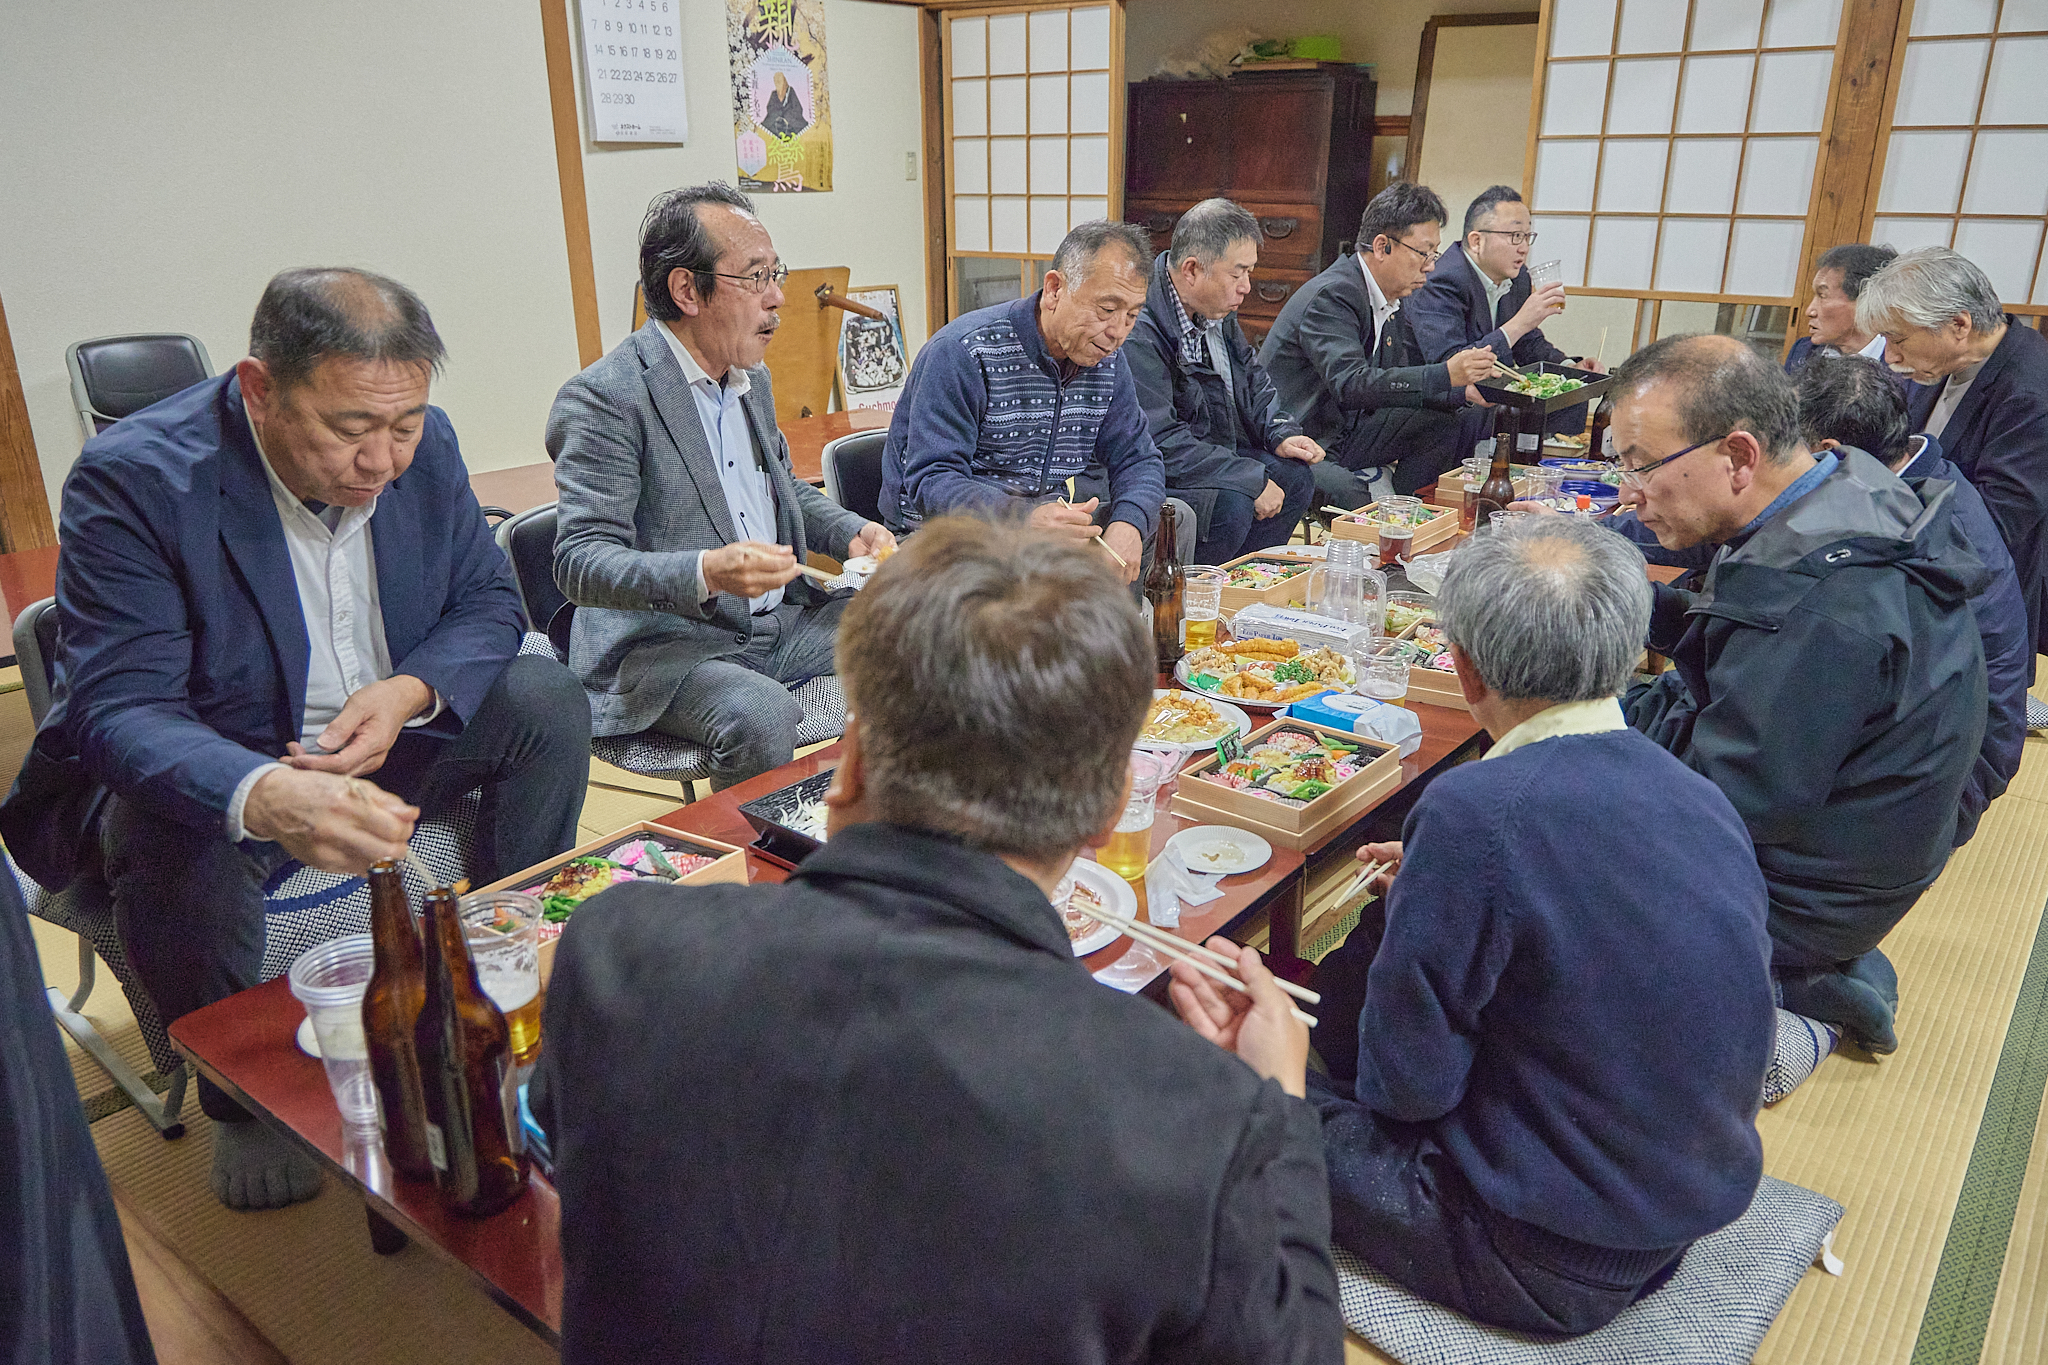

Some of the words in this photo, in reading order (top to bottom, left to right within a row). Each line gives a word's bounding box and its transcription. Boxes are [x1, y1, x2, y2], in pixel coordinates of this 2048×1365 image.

[627, 0, 632, 9] 3
[639, 1, 644, 10] 4
[651, 2, 656, 11] 5
[663, 3, 668, 12] 6
[592, 19, 597, 29] 7
[605, 21, 611, 31] 8
[617, 22, 622, 32] 9
[629, 23, 636, 33] 10
[641, 24, 647, 34] 11
[653, 25, 660, 35] 12
[665, 26, 672, 36] 13
[595, 45, 603, 54] 14
[608, 45, 615, 55] 15
[620, 46, 627, 56] 16
[632, 47, 638, 57] 17
[643, 48, 650, 58] 18
[655, 49, 662, 59] 19
[667, 50, 676, 60] 20
[598, 69, 607, 79] 21
[610, 69, 620, 80] 22
[623, 70, 632, 81] 23
[634, 71, 642, 81] 24
[645, 72, 655, 82] 25
[657, 73, 667, 83] 26
[669, 74, 677, 83] 27
[601, 93, 611, 103] 28
[613, 94, 623, 104] 29
[625, 94, 635, 104] 30
